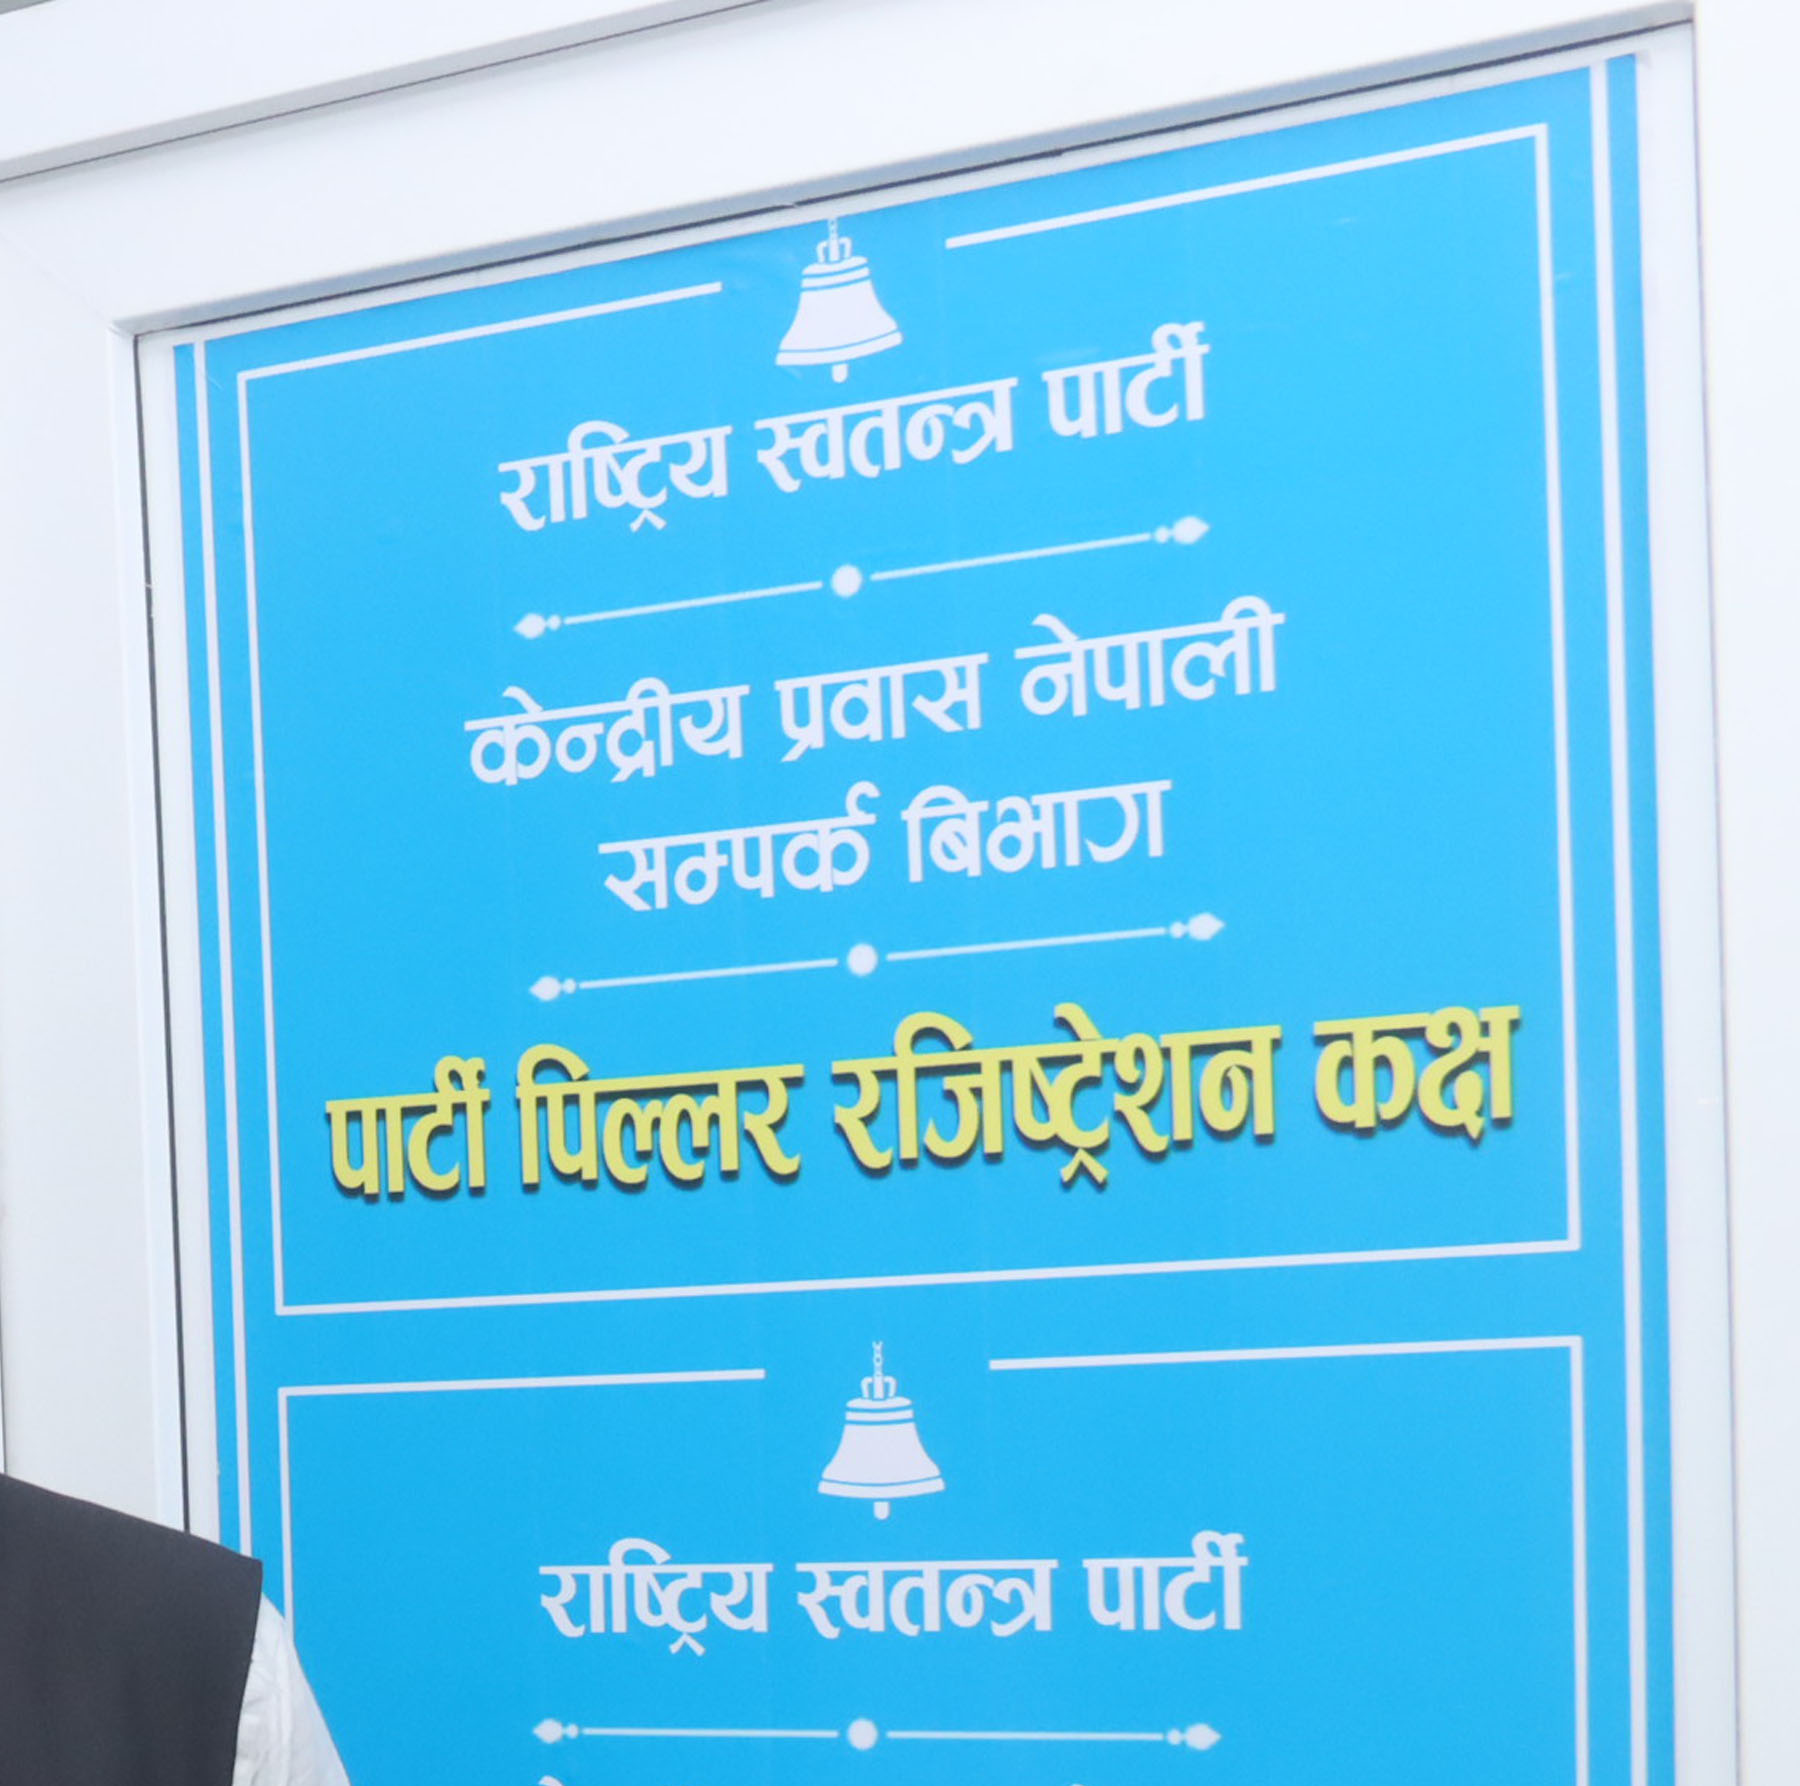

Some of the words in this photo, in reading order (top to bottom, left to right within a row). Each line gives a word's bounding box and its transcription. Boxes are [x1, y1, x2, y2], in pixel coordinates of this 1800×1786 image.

[498, 420, 732, 532] राष्ट्रिय
[754, 377, 1017, 493] स्वतन्त्र
[1041, 321, 1210, 438] पार्टी
[464, 680, 750, 786] केन्द्रीय
[774, 652, 990, 762] प्रवास
[1014, 595, 1286, 717] नेपाली
[598, 782, 880, 911] सम्पर्क
[901, 779, 1173, 883] बिभाग
[326, 1056, 488, 1196] पार्टी
[516, 1044, 805, 1188] पिल्लर
[832, 1003, 1282, 1184] रजिष्ट्रेशन
[1313, 1005, 1521, 1139] कक्ष
[540, 1538, 774, 1655] राष्ट्रिय
[796, 1559, 1059, 1639] स्वतन्त्र
[1083, 1531, 1248, 1630] पार्टी
